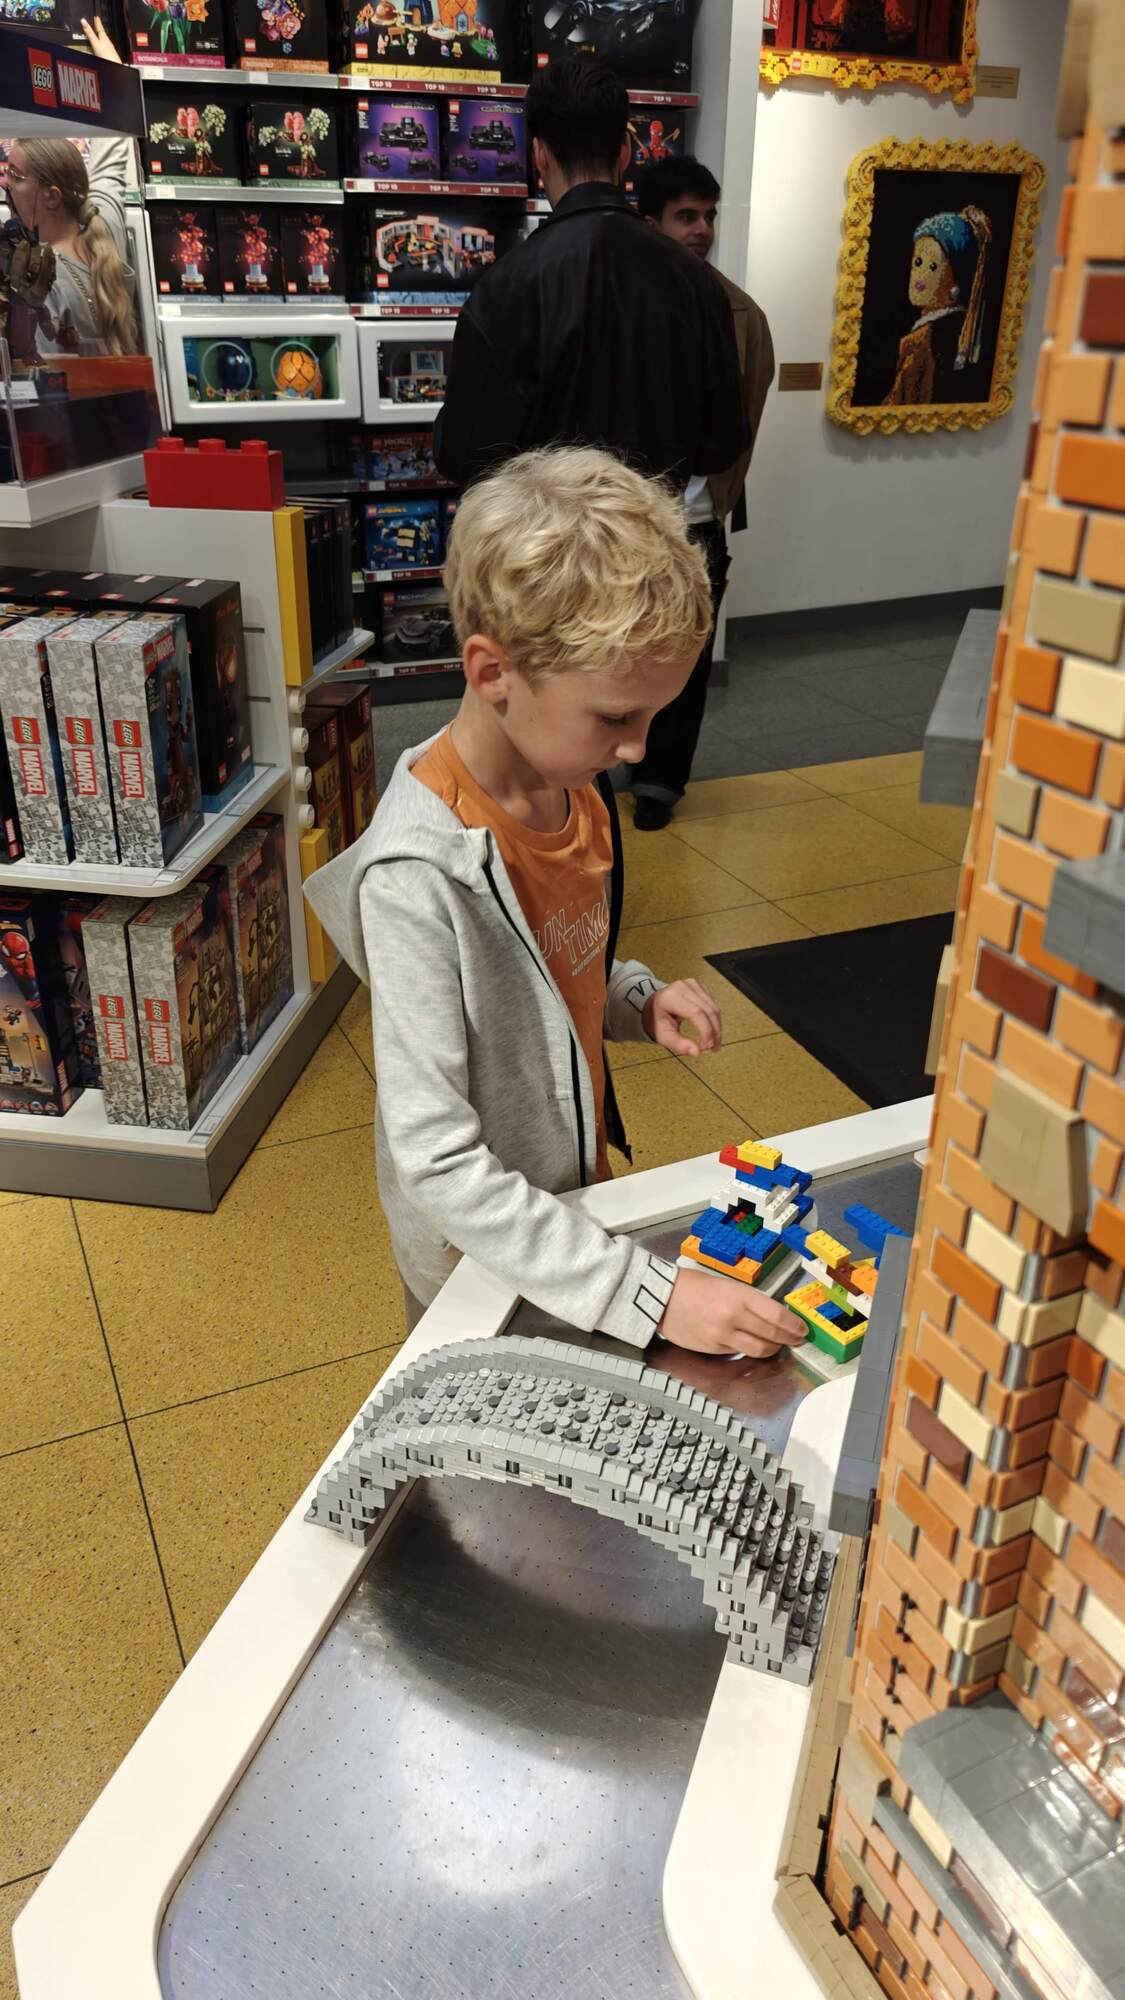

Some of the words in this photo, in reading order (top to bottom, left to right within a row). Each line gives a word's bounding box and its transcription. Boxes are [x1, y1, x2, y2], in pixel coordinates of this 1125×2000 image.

[33, 66, 52, 89] LEGO
[57, 63, 101, 110] MARVEL
[371, 80, 384, 88] TOP
[21, 719, 33, 742] LEGO
[73, 720, 87, 744] LEGO
[121, 723, 134, 745] LEGO
[21, 750, 45, 793] MARVEL
[73, 751, 96, 793] MARVEL
[121, 754, 144, 796] MARVEL
[107, 998, 118, 1016] LEGO
[152, 1001, 162, 1020] LEGO
[106, 1022, 126, 1059] MARVEL
[151, 1026, 170, 1063] MARVEL
